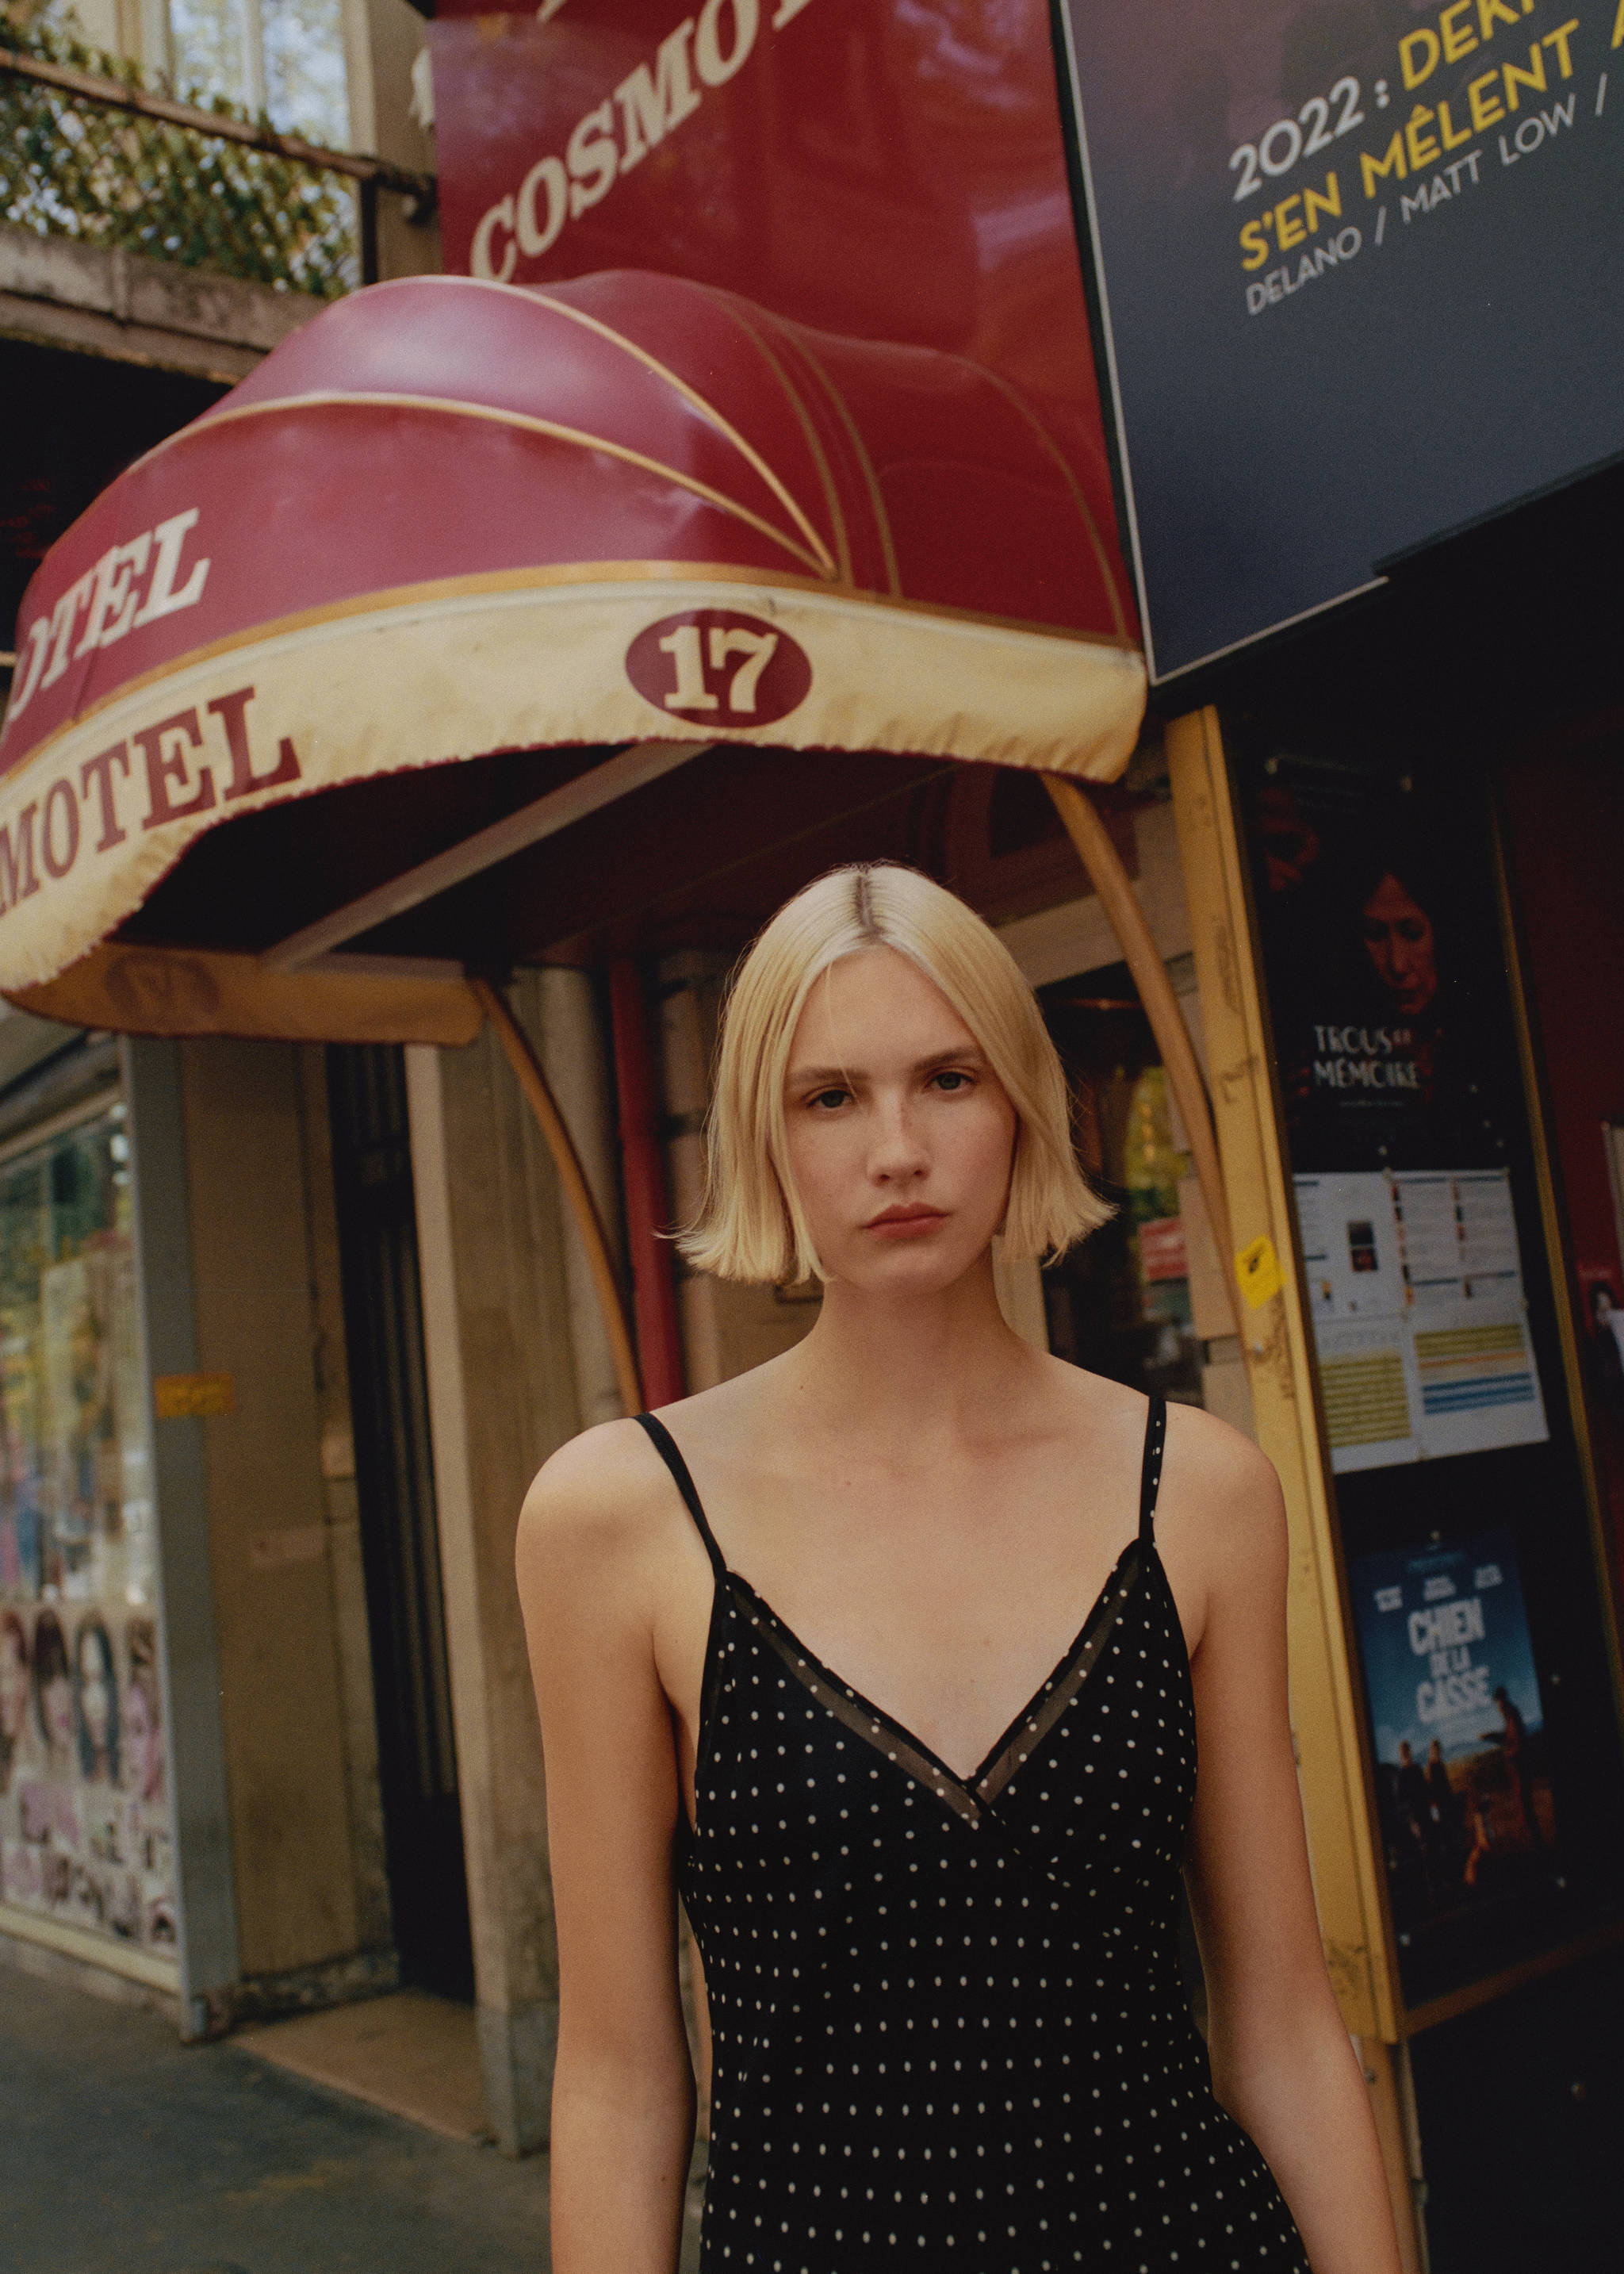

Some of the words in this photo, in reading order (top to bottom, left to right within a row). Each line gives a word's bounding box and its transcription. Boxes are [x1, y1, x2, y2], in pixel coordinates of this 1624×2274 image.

[1398, 0, 1535, 91] DER
[1239, 171, 1342, 270] S'EN
[1359, 18, 1580, 198] MÊLENT
[1246, 226, 1362, 315] DELANO
[1400, 149, 1483, 224] MATT
[1499, 93, 1576, 166] LOW
[659, 625, 779, 713] 17
[0, 685, 302, 918] MOTEL
[1408, 1597, 1485, 1655] CHIEN
